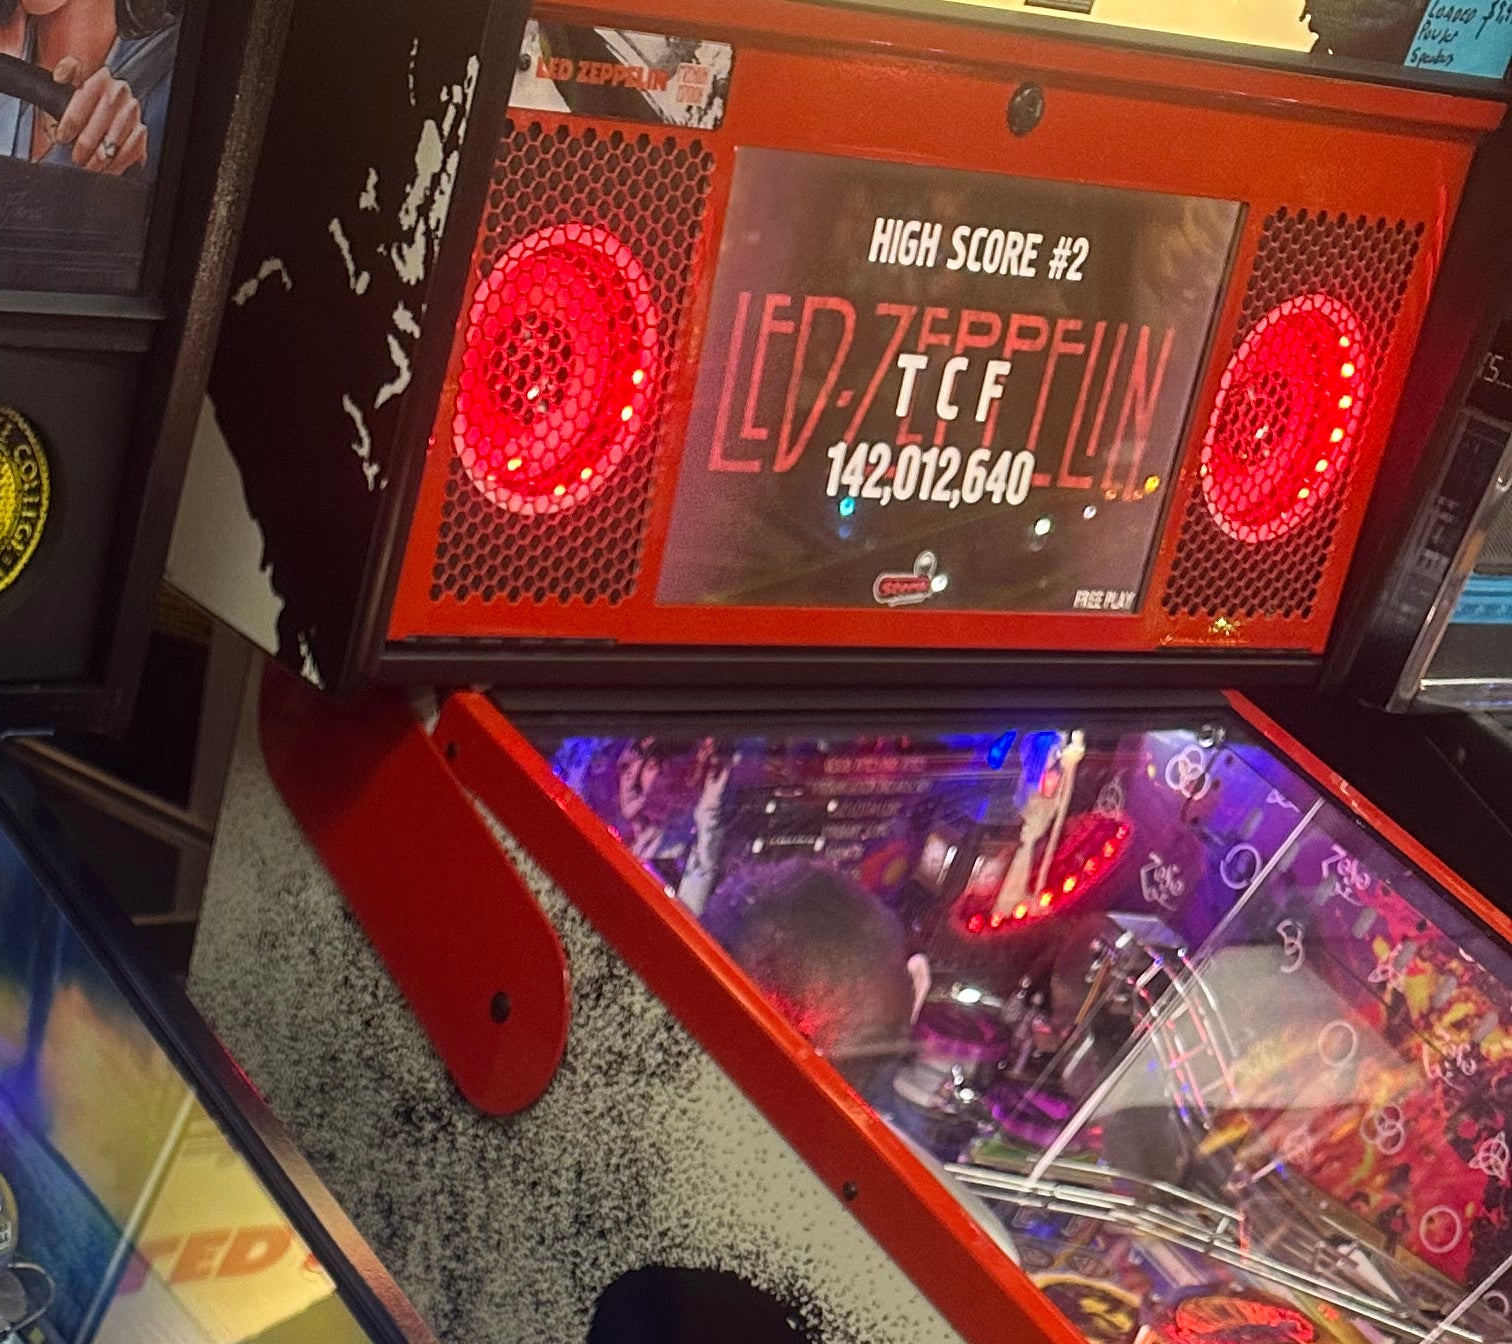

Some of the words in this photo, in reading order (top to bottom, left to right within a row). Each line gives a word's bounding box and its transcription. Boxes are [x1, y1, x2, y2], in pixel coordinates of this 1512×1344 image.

[536, 56, 574, 81] LED
[576, 60, 671, 92] ZEPPELIN
[869, 217, 943, 268] HIGH
[946, 226, 1043, 278] SCORE
[1048, 236, 1090, 281] #2
[826, 441, 1035, 509] 142,012,640
[1073, 590, 1103, 609] FREE
[1105, 591, 1136, 610] PLAY
